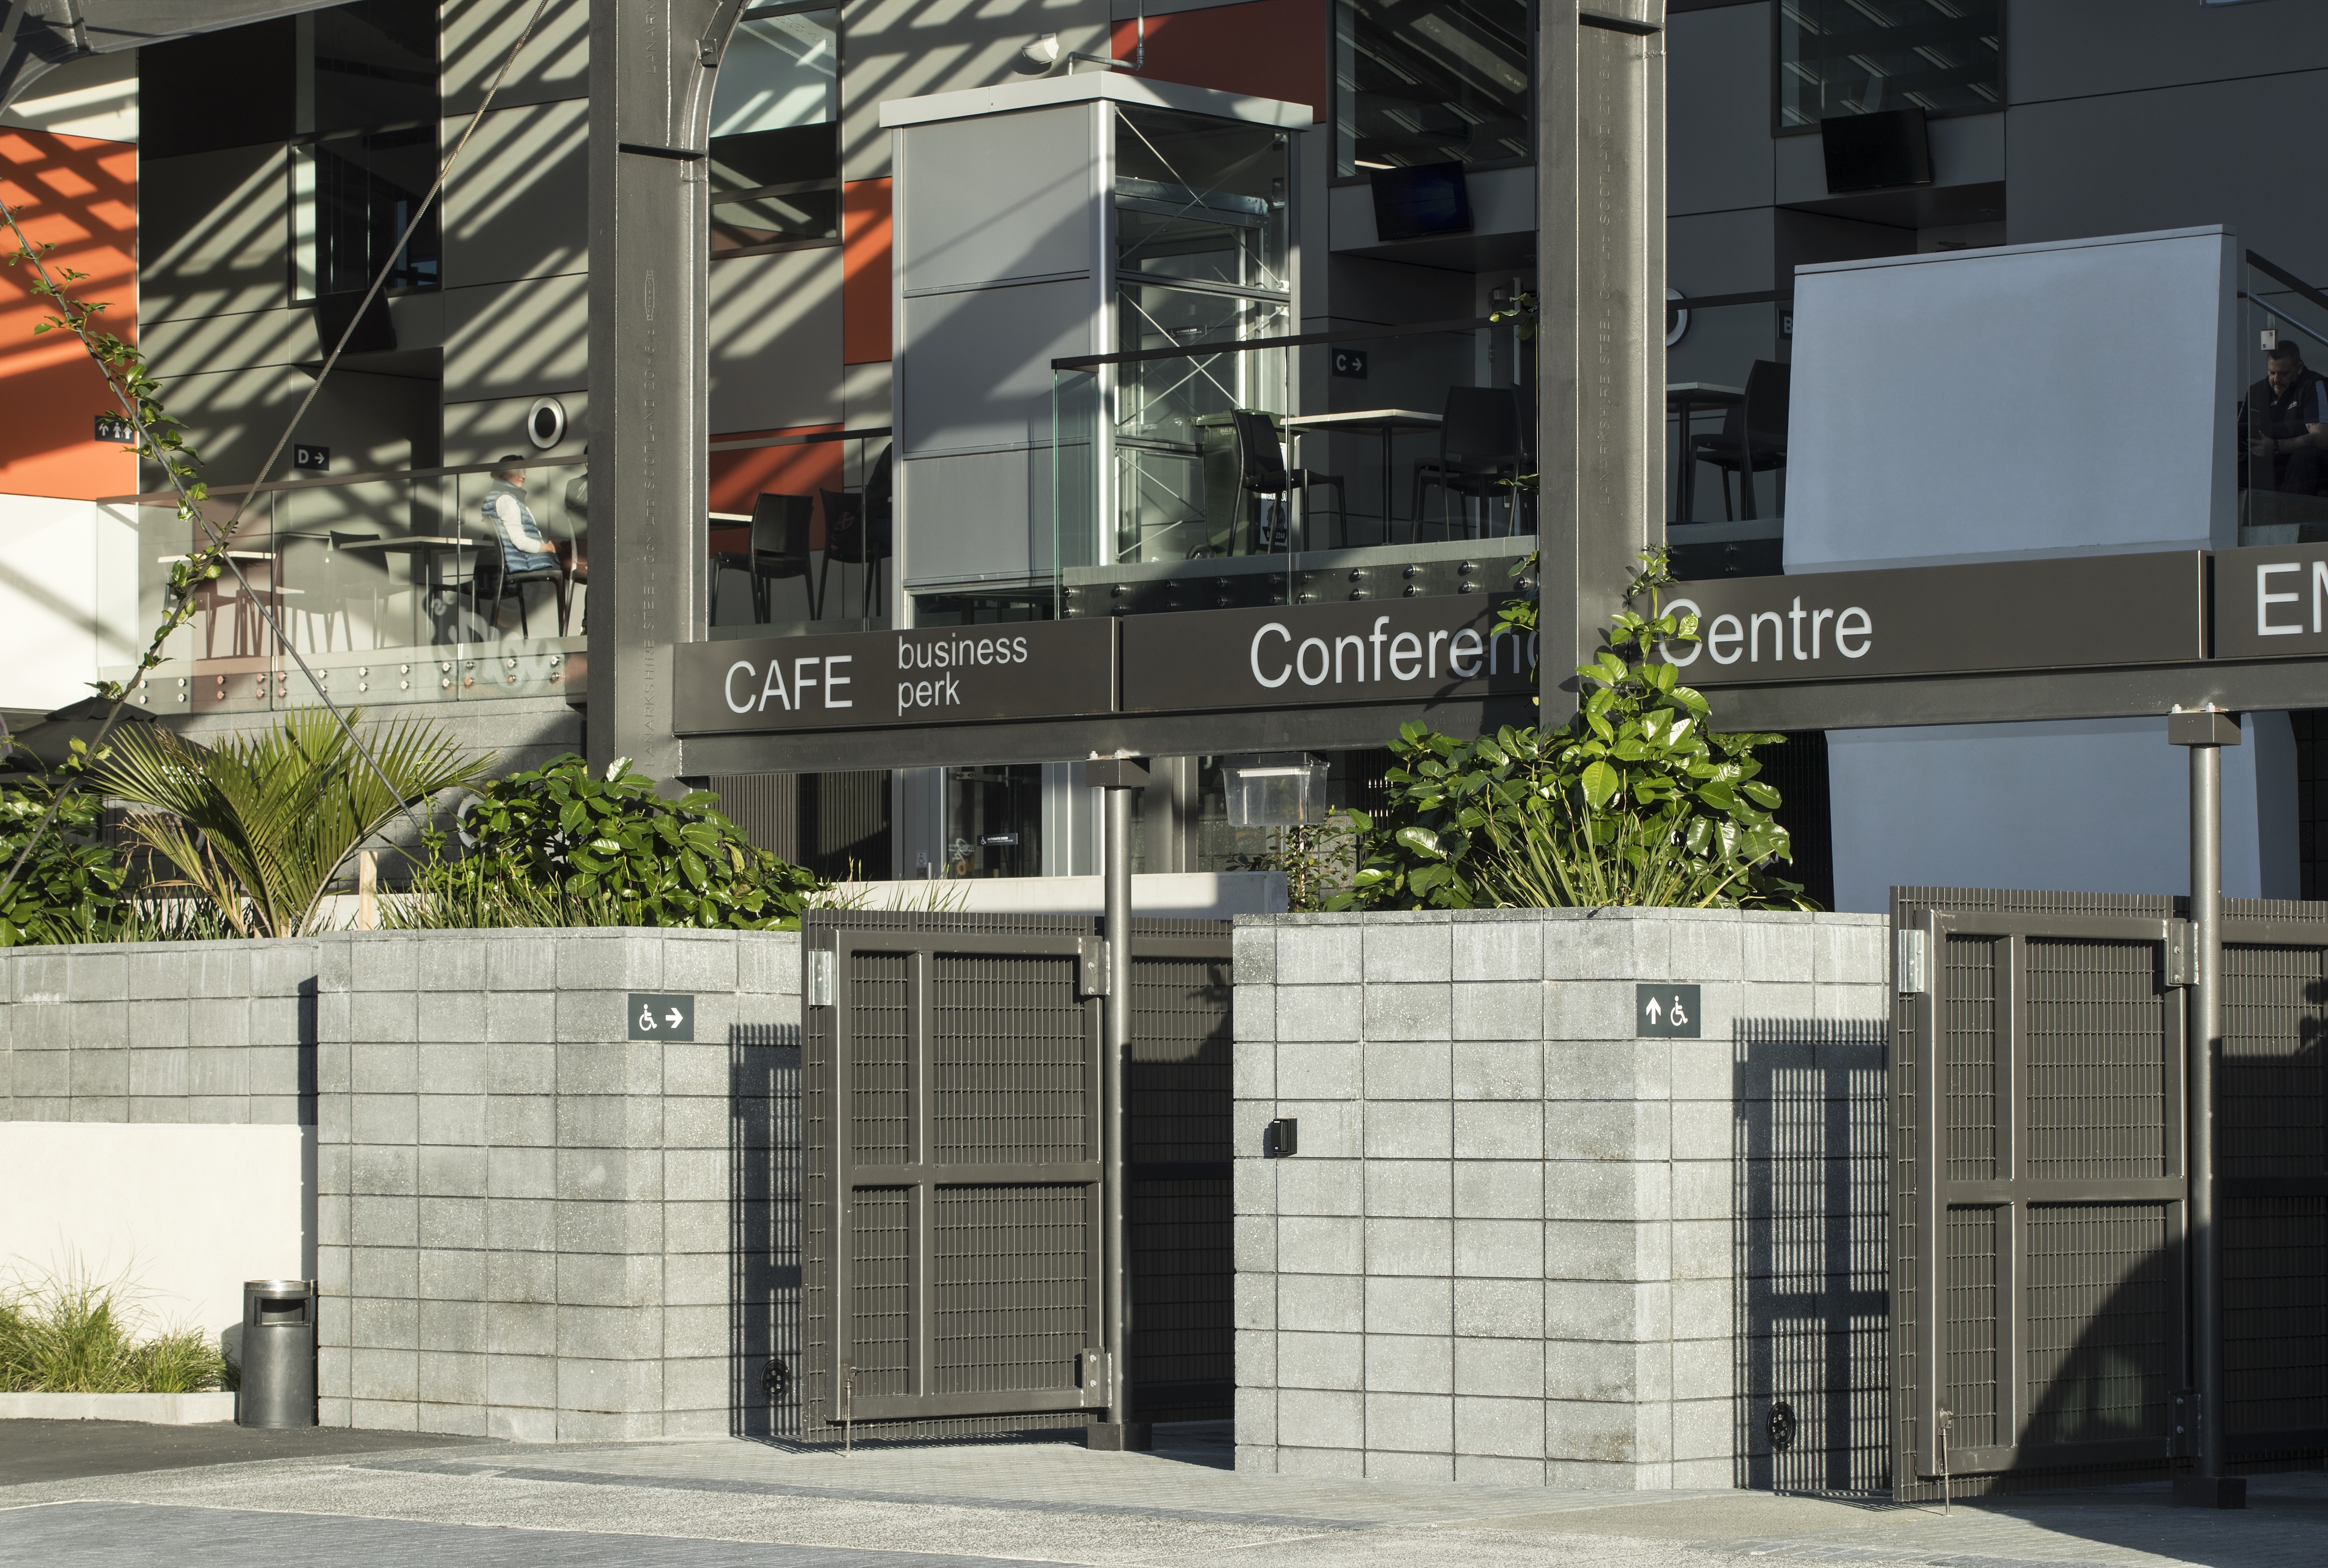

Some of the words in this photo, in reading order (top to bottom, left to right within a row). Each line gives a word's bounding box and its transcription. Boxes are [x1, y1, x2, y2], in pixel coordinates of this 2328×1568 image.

[646, 0, 656, 75] LANARK
[1784, 316, 1793, 334] B
[1337, 355, 1346, 371] C
[298, 450, 308, 463] D
[643, 398, 656, 490] SCOTLAND
[643, 572, 655, 631] STEEL
[899, 632, 1028, 669] business
[1251, 616, 1540, 688] Conferen
[1658, 596, 1872, 667] Centre
[643, 639, 655, 766] LANARKSHIRE
[724, 655, 853, 714] CAFE
[898, 671, 960, 717] perk
